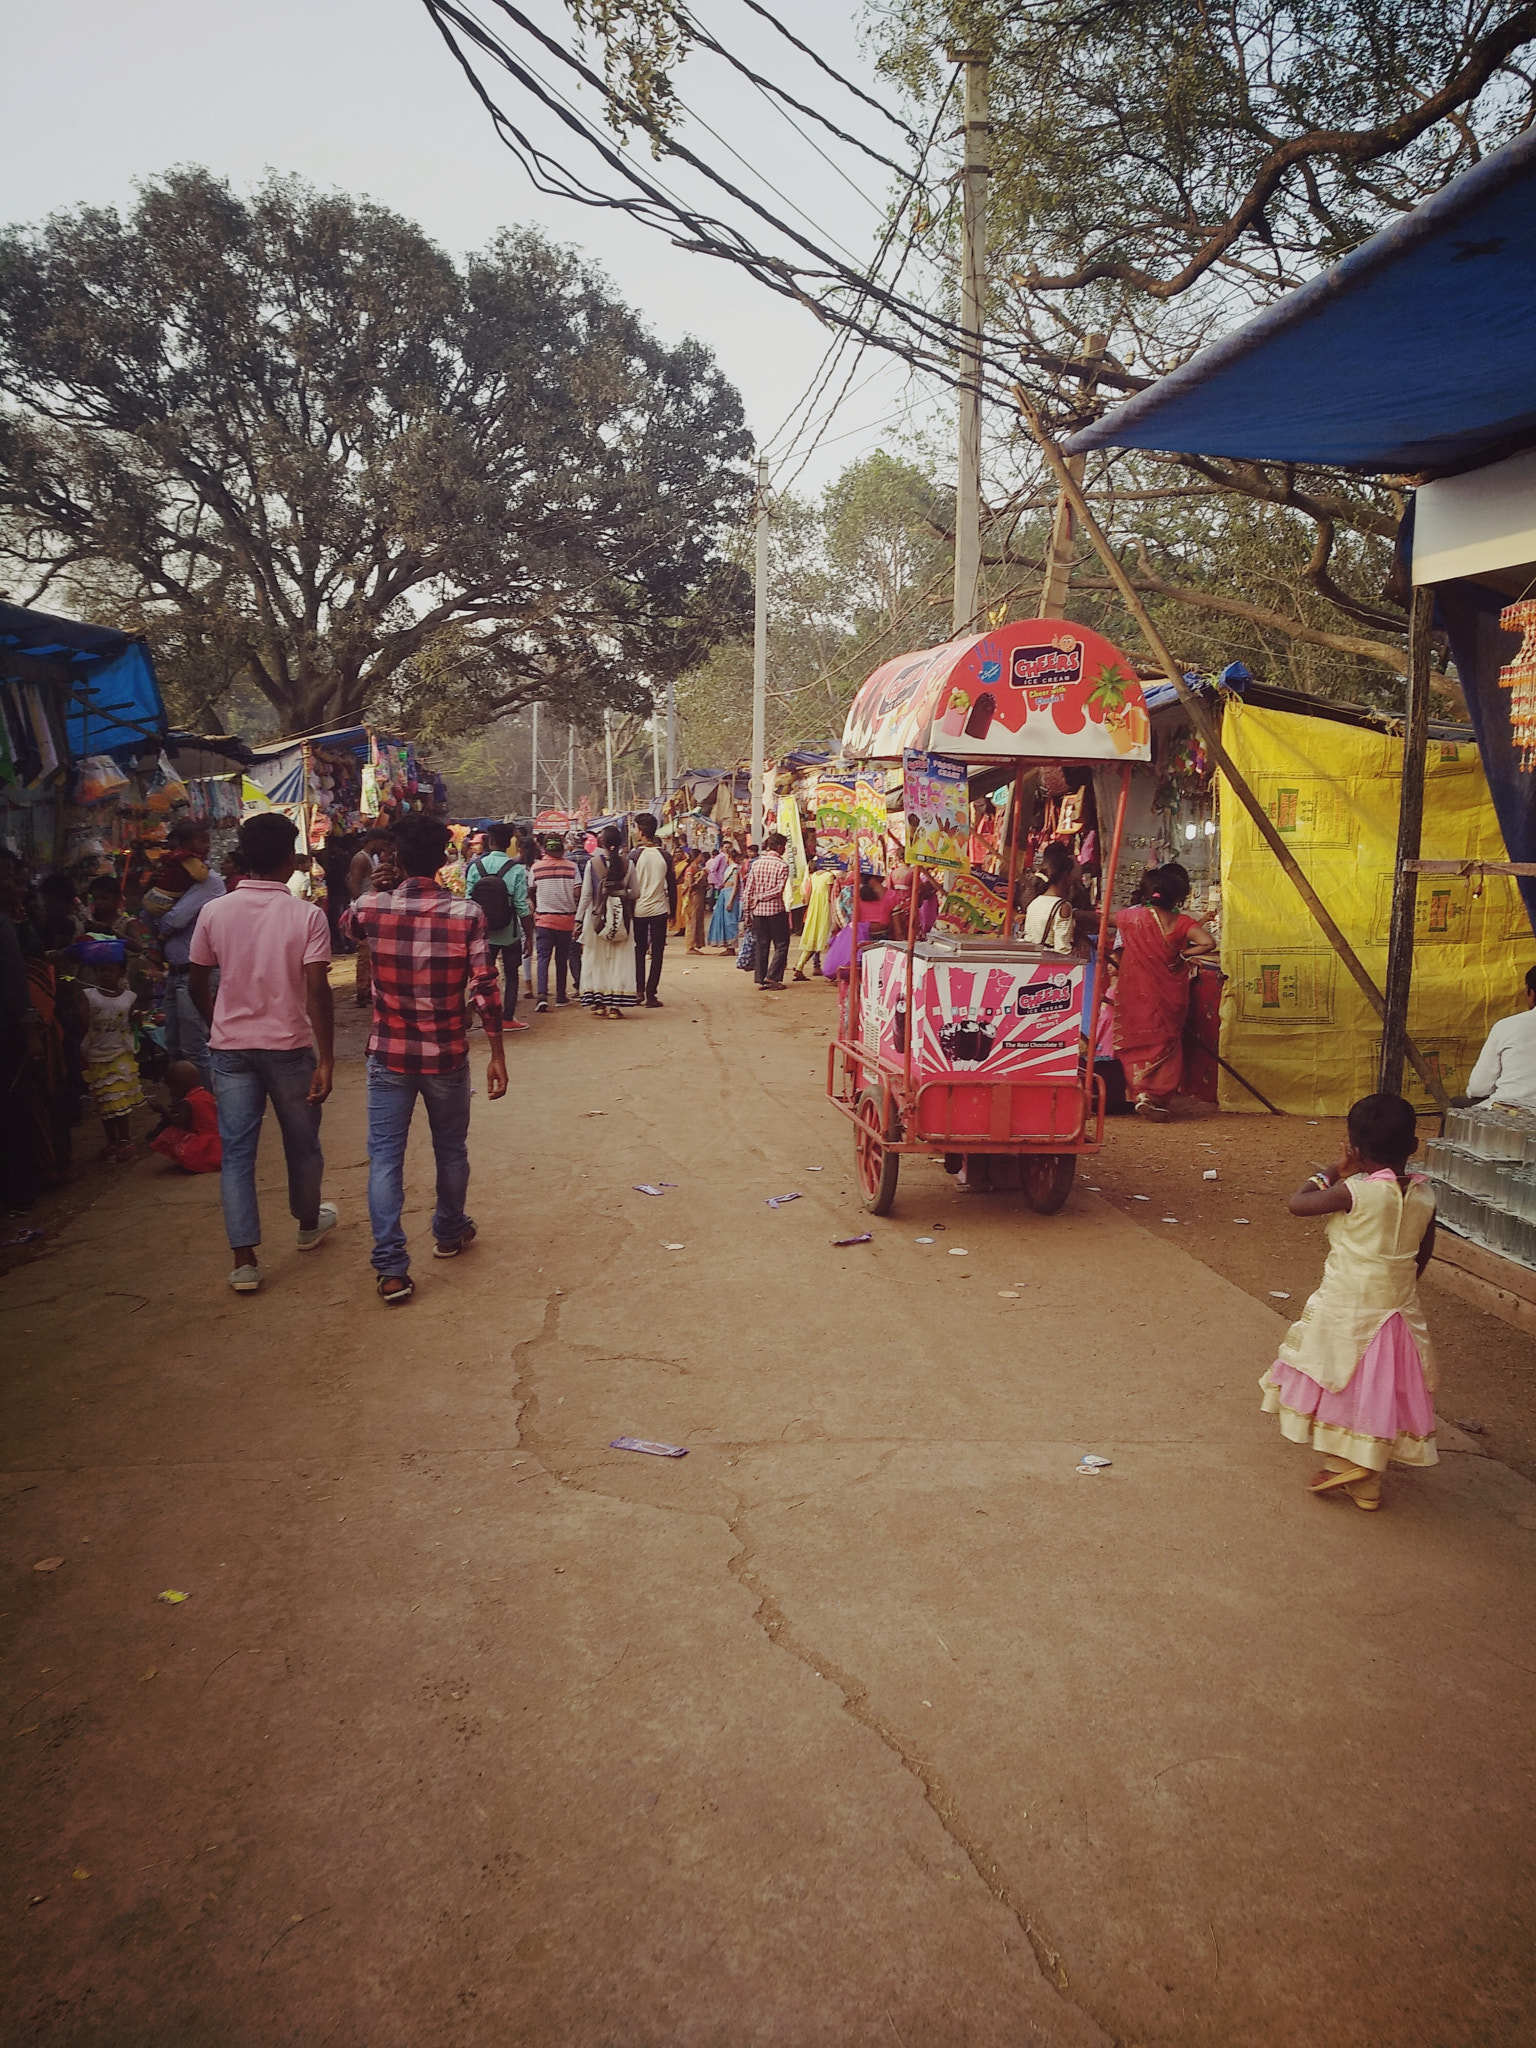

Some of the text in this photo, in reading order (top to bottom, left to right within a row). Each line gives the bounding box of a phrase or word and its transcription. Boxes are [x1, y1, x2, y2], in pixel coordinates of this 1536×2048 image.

[1014, 651, 1080, 679] CHEERS
[1029, 686, 1066, 699] Cheer with
[1019, 986, 1070, 1009] CHEERS
